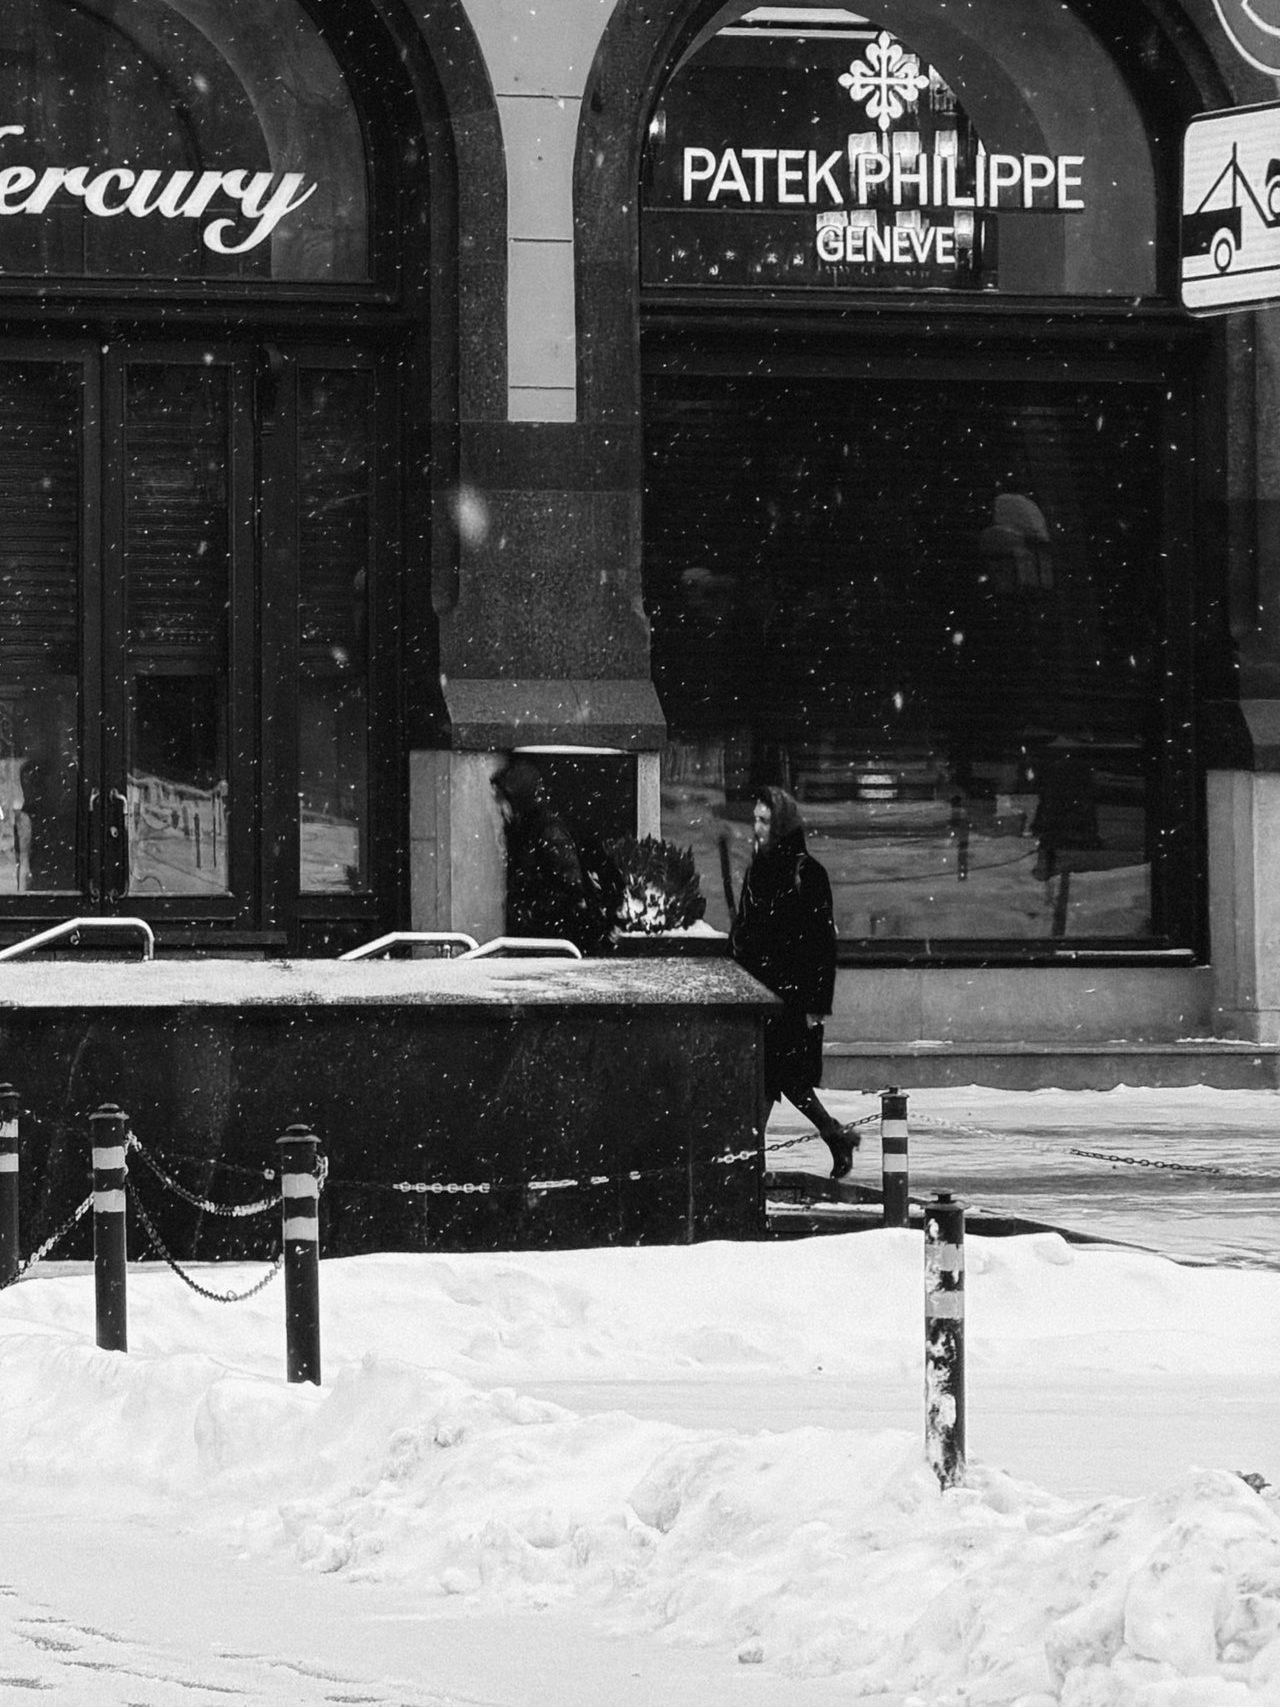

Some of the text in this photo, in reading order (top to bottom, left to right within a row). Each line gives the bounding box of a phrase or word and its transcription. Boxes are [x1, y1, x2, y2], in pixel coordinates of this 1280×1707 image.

[683, 147, 1085, 209] PATEK PHILIPPE
[816, 225, 955, 264] GENEVE
